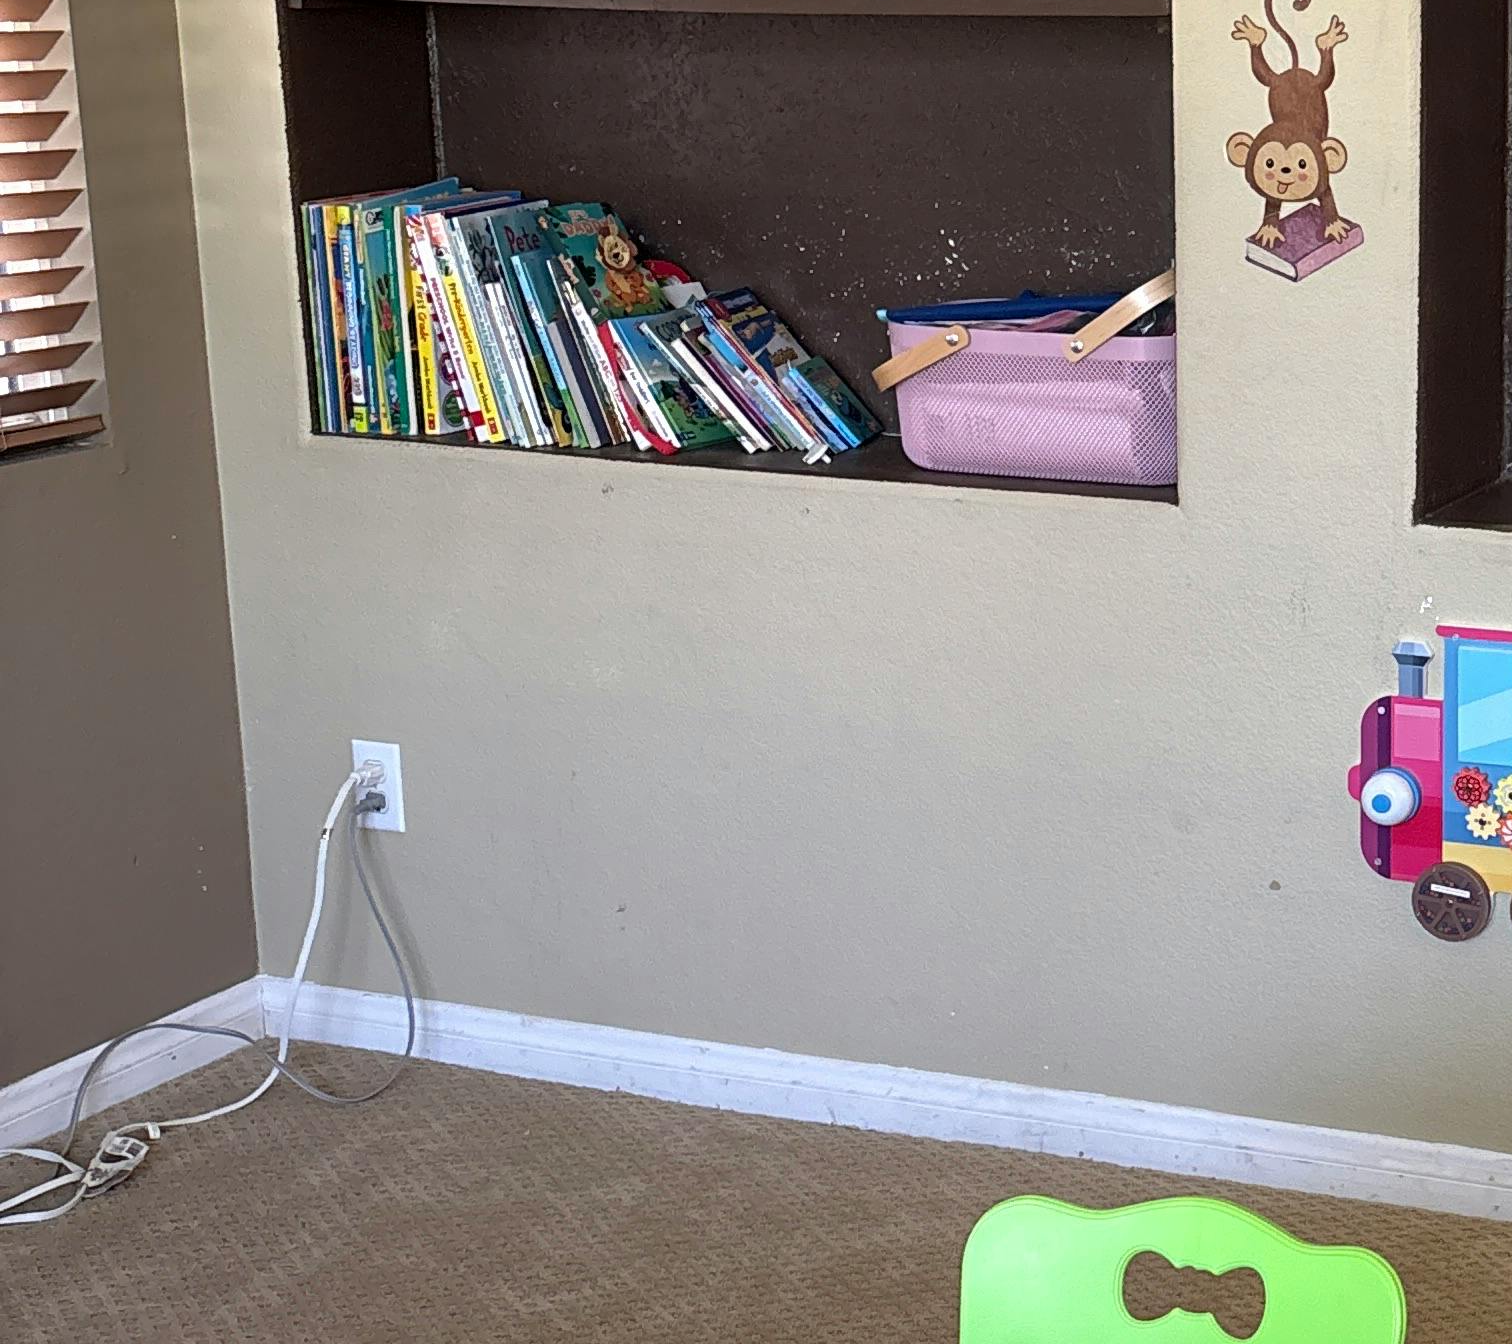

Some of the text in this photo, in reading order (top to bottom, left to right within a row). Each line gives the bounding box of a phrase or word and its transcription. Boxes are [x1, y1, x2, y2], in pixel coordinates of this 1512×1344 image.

[504, 225, 541, 255] Pete
[415, 285, 426, 309] First
[429, 277, 450, 324] PRESCHOOL
[417, 312, 428, 342] Grade
[447, 282, 475, 354] Pre-Kindergarten
